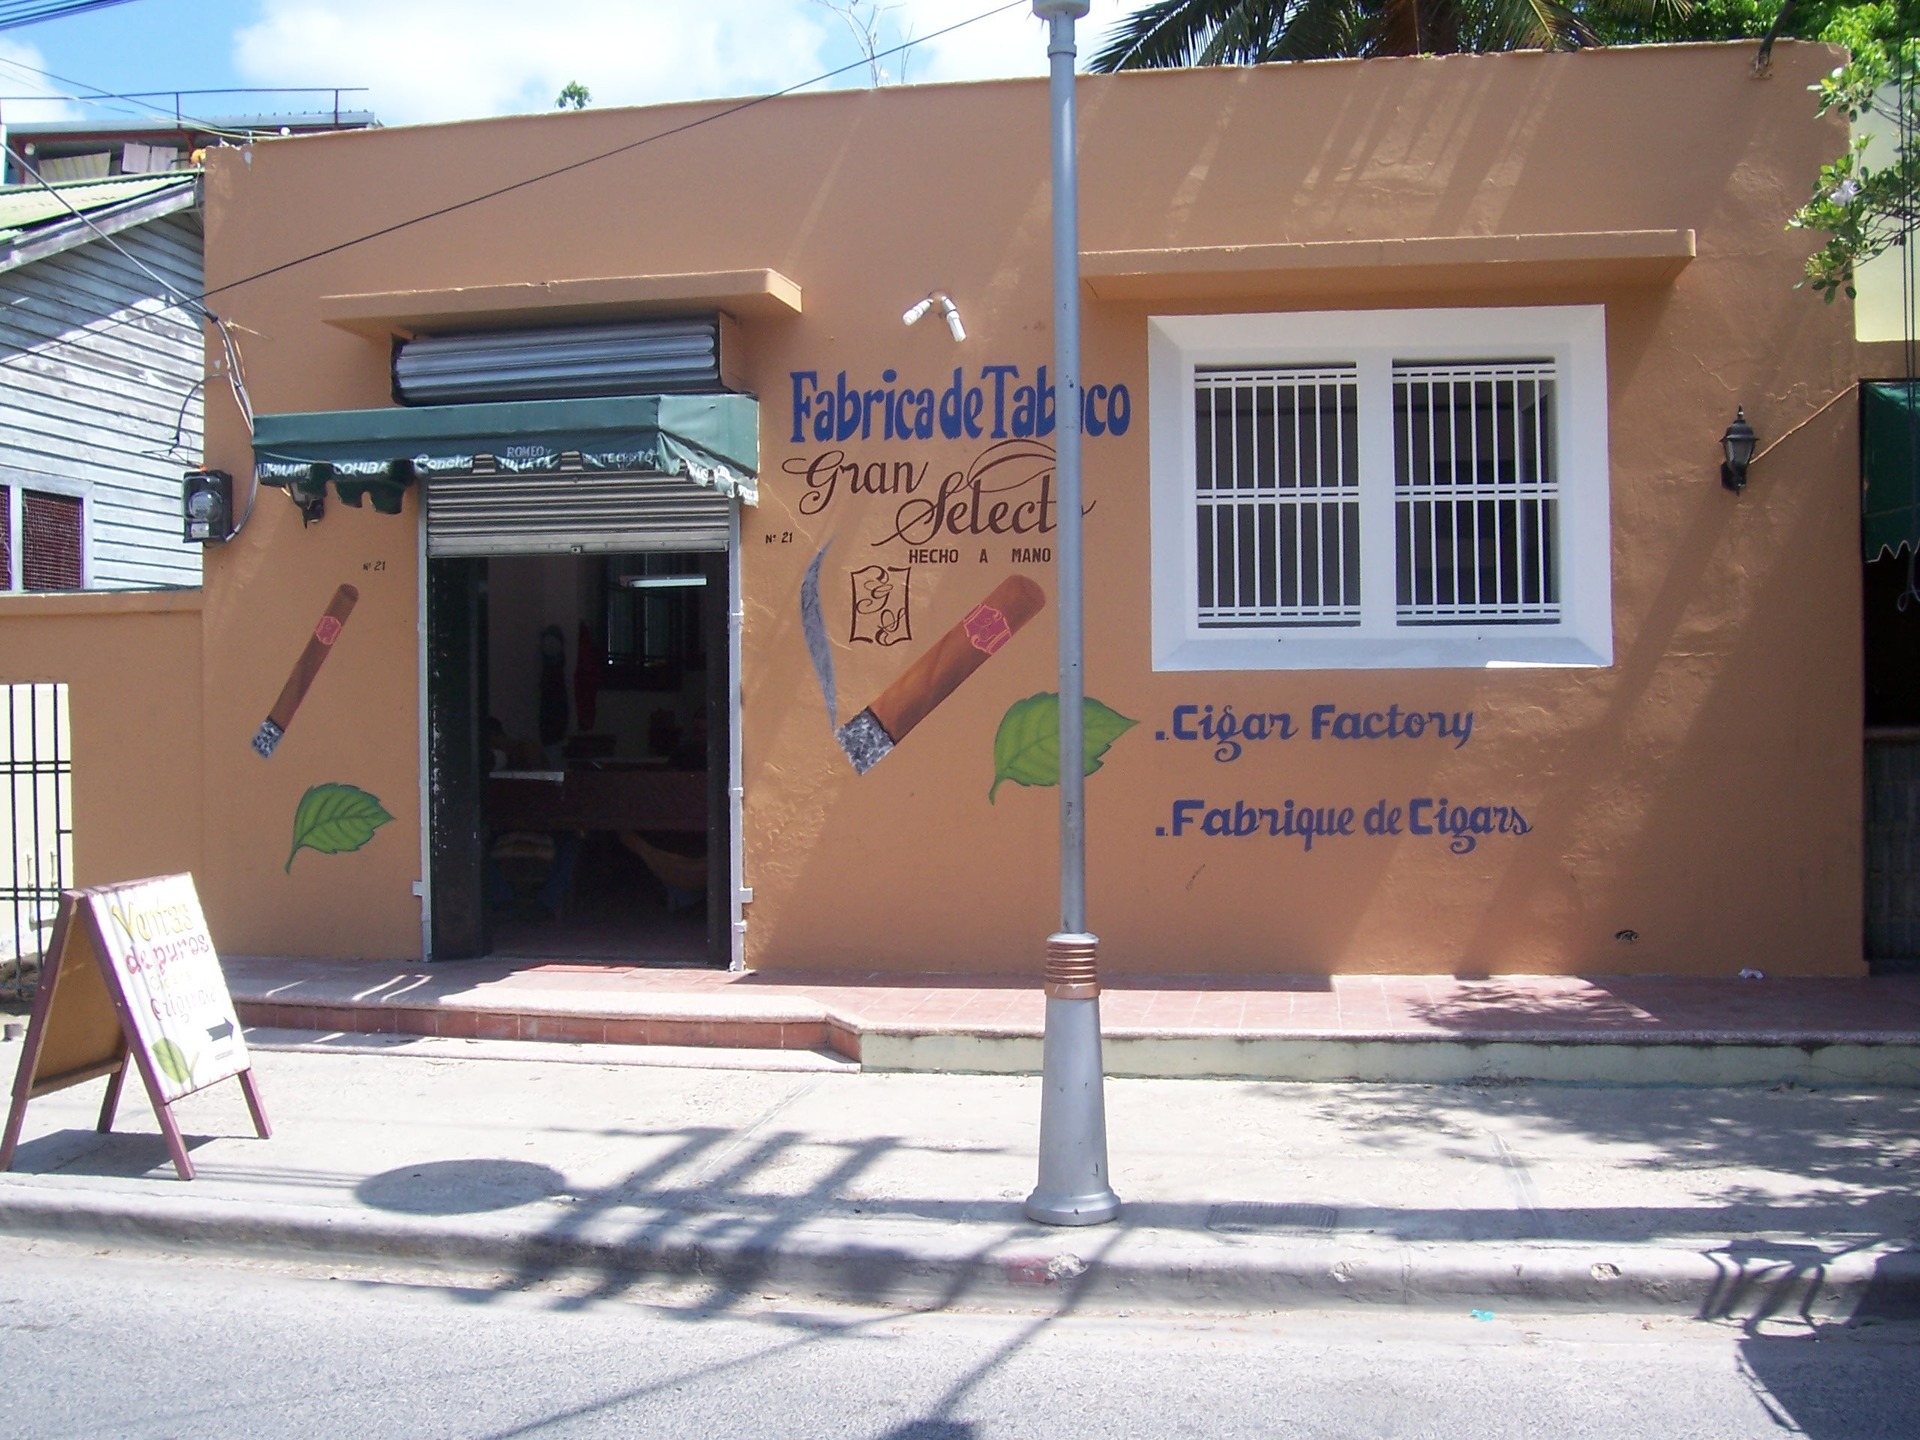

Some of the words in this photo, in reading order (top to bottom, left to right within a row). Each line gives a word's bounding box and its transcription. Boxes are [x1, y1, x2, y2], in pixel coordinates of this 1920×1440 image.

[790, 368, 934, 443] Fabrica
[939, 366, 985, 440] de
[981, 364, 1131, 440] Tabco
[782, 450, 929, 515] Gran
[871, 471, 1096, 546] Select
[781, 531, 793, 543] 21
[908, 548, 959, 564] HECHO
[979, 549, 988, 563] A
[1011, 547, 1051, 563] MANO
[374, 560, 386, 571] 21
[1311, 704, 1474, 750] Factory
[1363, 799, 1405, 836] de
[1408, 798, 1534, 855] Cigars
[125, 944, 153, 975] de
